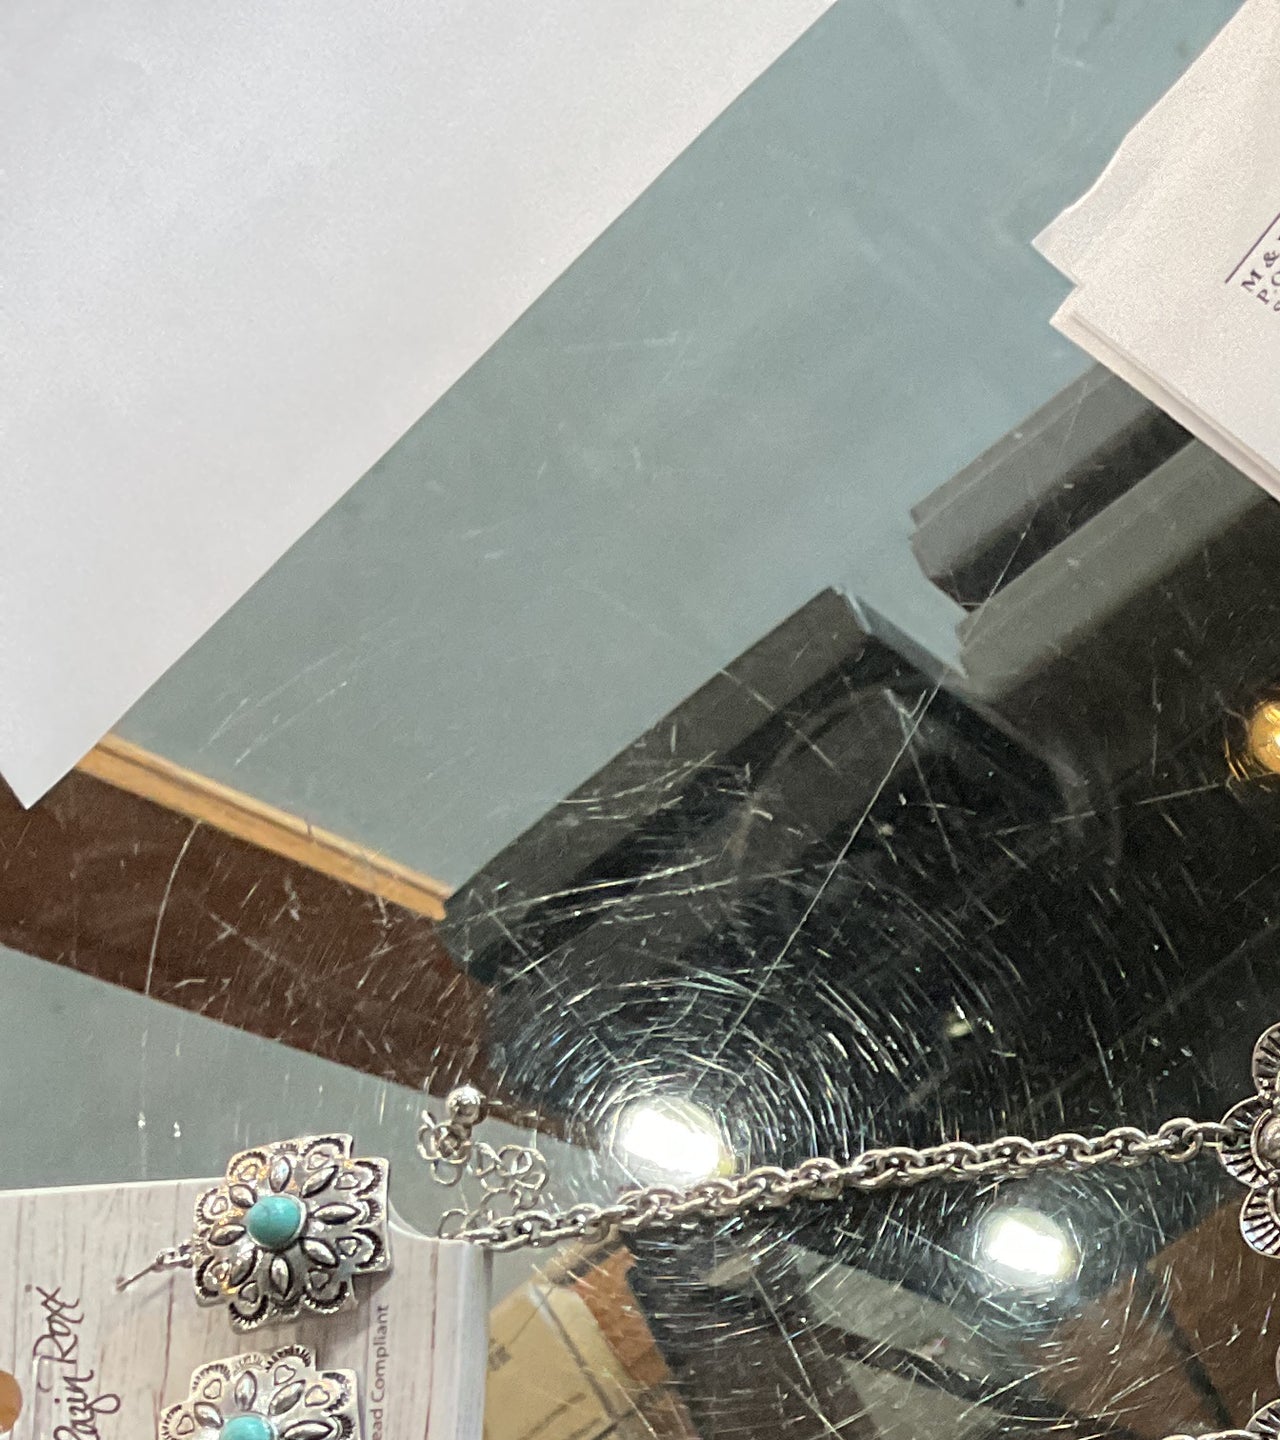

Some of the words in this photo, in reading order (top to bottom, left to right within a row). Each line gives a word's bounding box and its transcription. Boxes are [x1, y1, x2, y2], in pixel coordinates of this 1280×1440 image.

[1240, 268, 1263, 292] M
[1262, 249, 1280, 268] &
[32, 1285, 85, 1393] Roxx
[370, 1302, 392, 1403] Compliant
